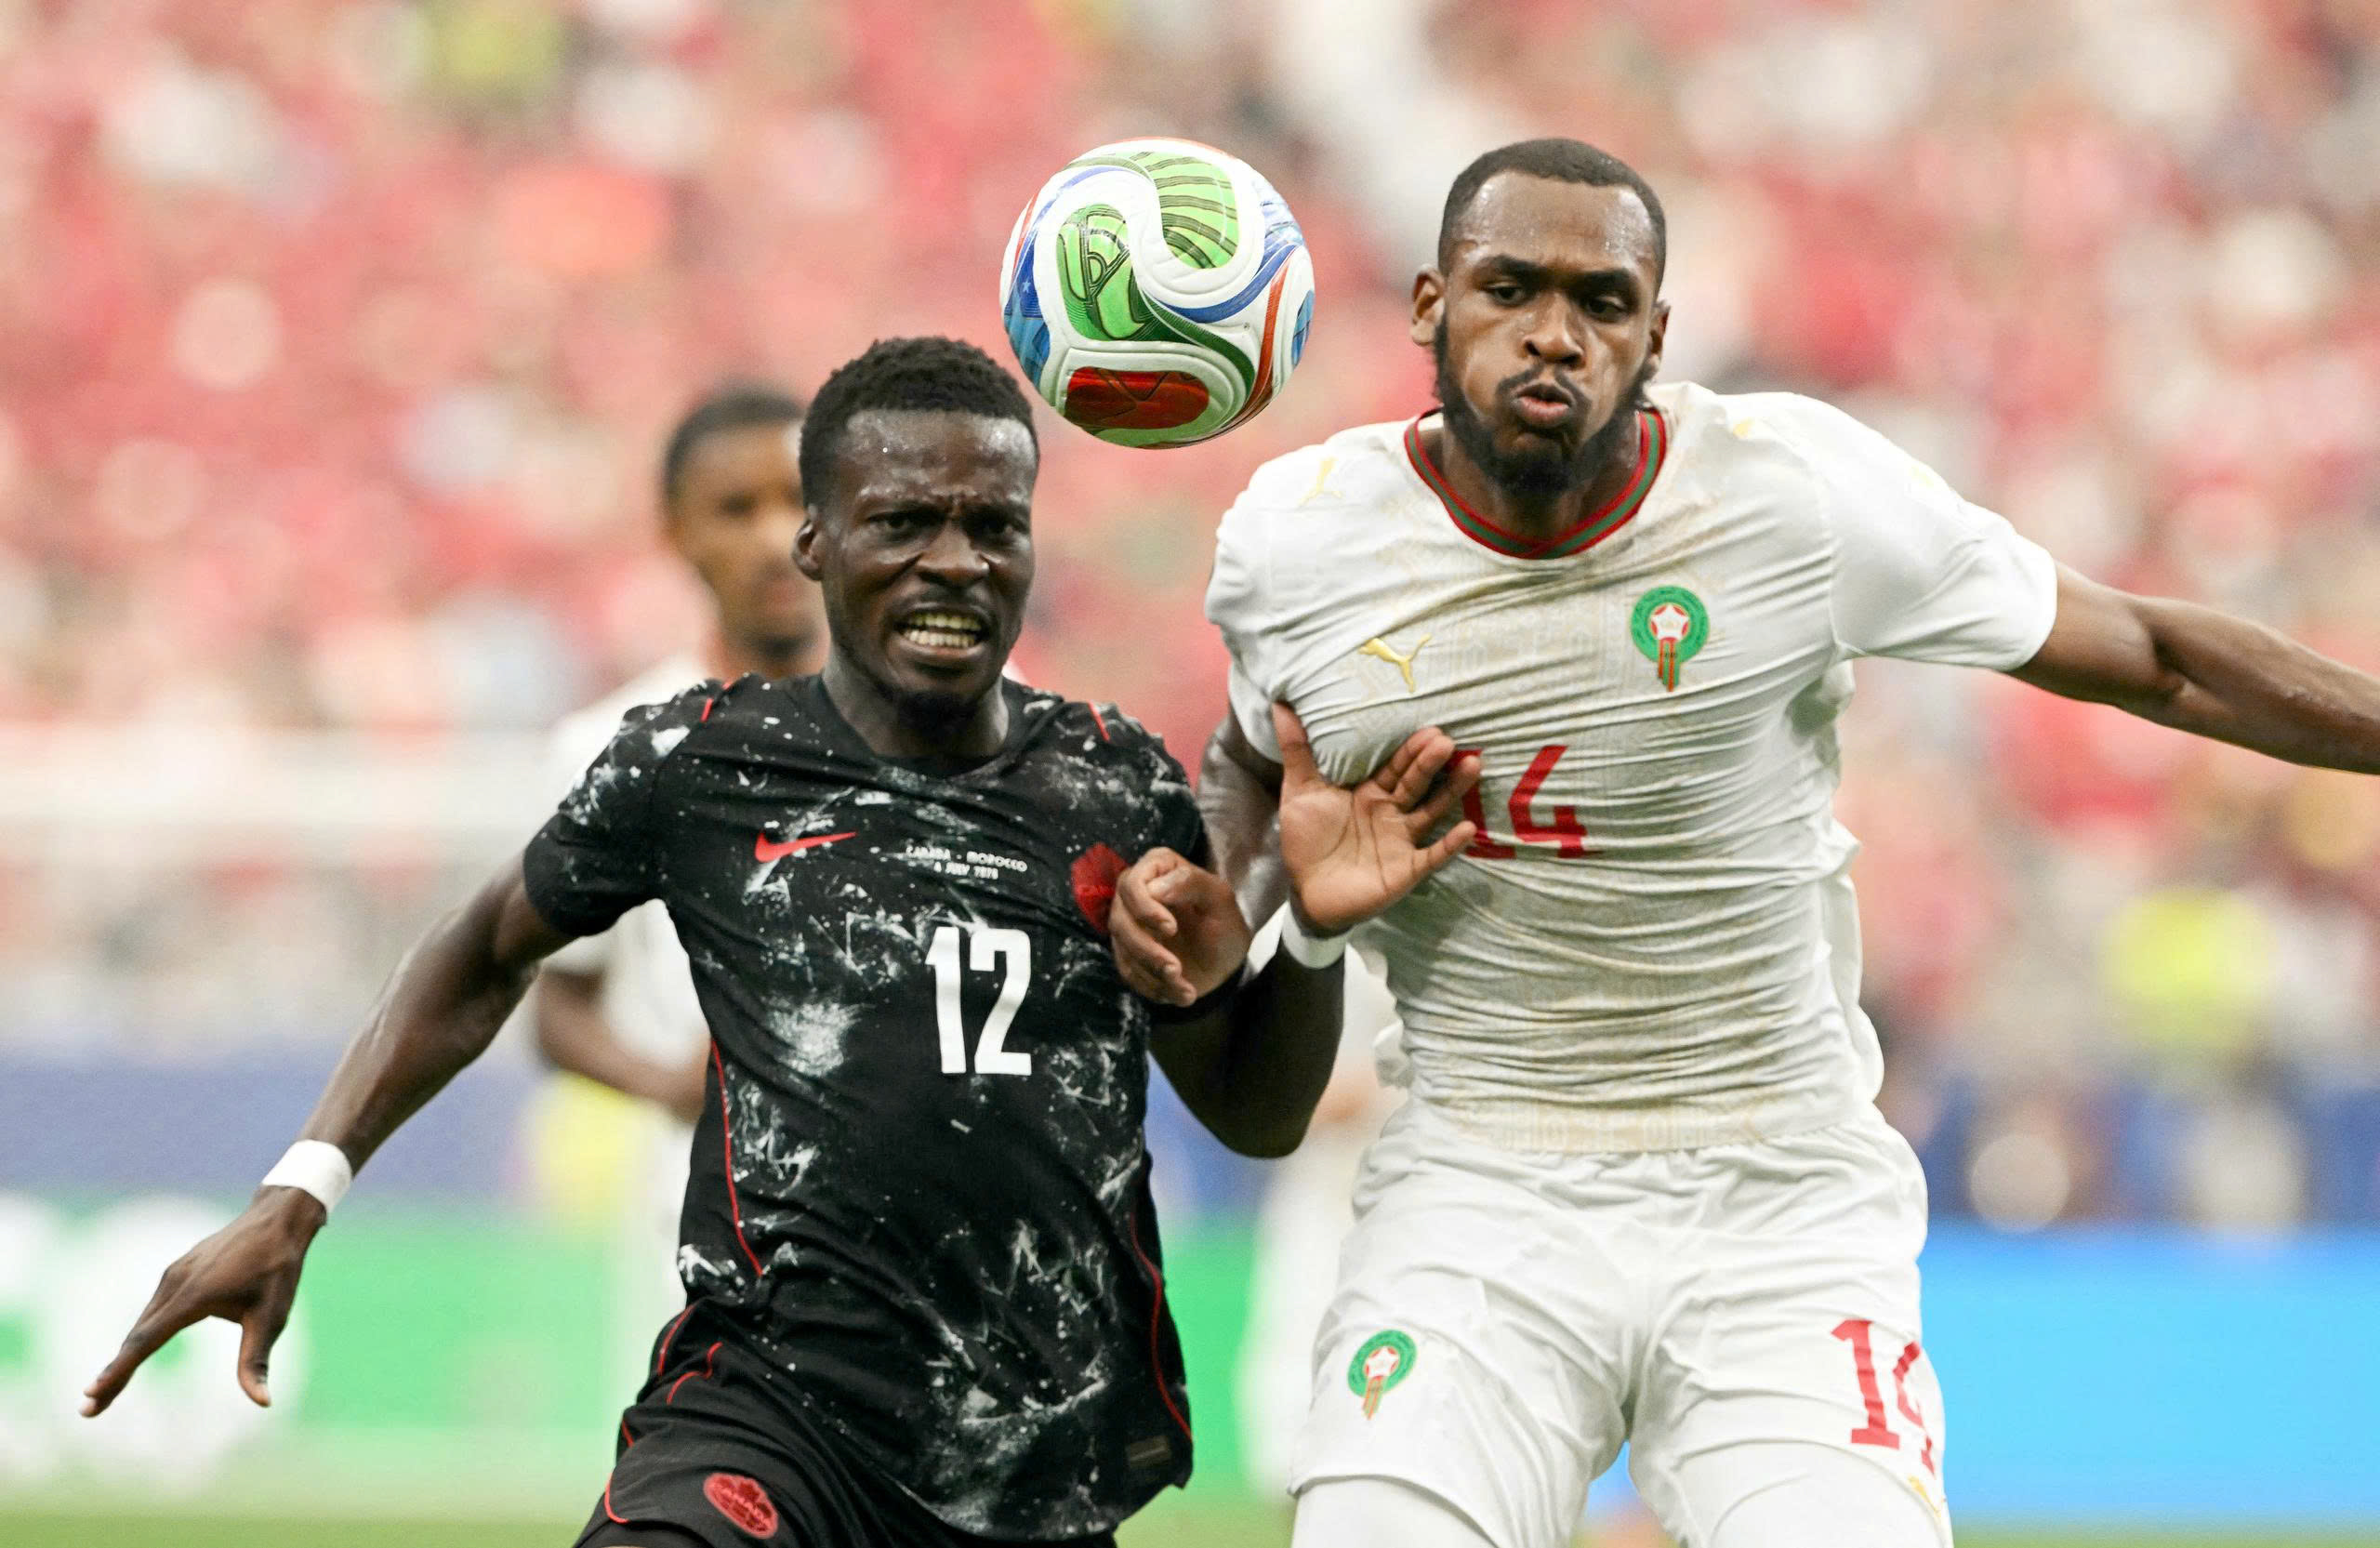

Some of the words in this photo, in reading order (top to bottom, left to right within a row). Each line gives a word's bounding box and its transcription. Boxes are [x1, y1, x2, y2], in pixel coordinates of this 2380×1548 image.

[1446, 745, 1592, 858] 14
[966, 851, 1027, 872] MOROCCO
[925, 926, 1032, 1076] 12
